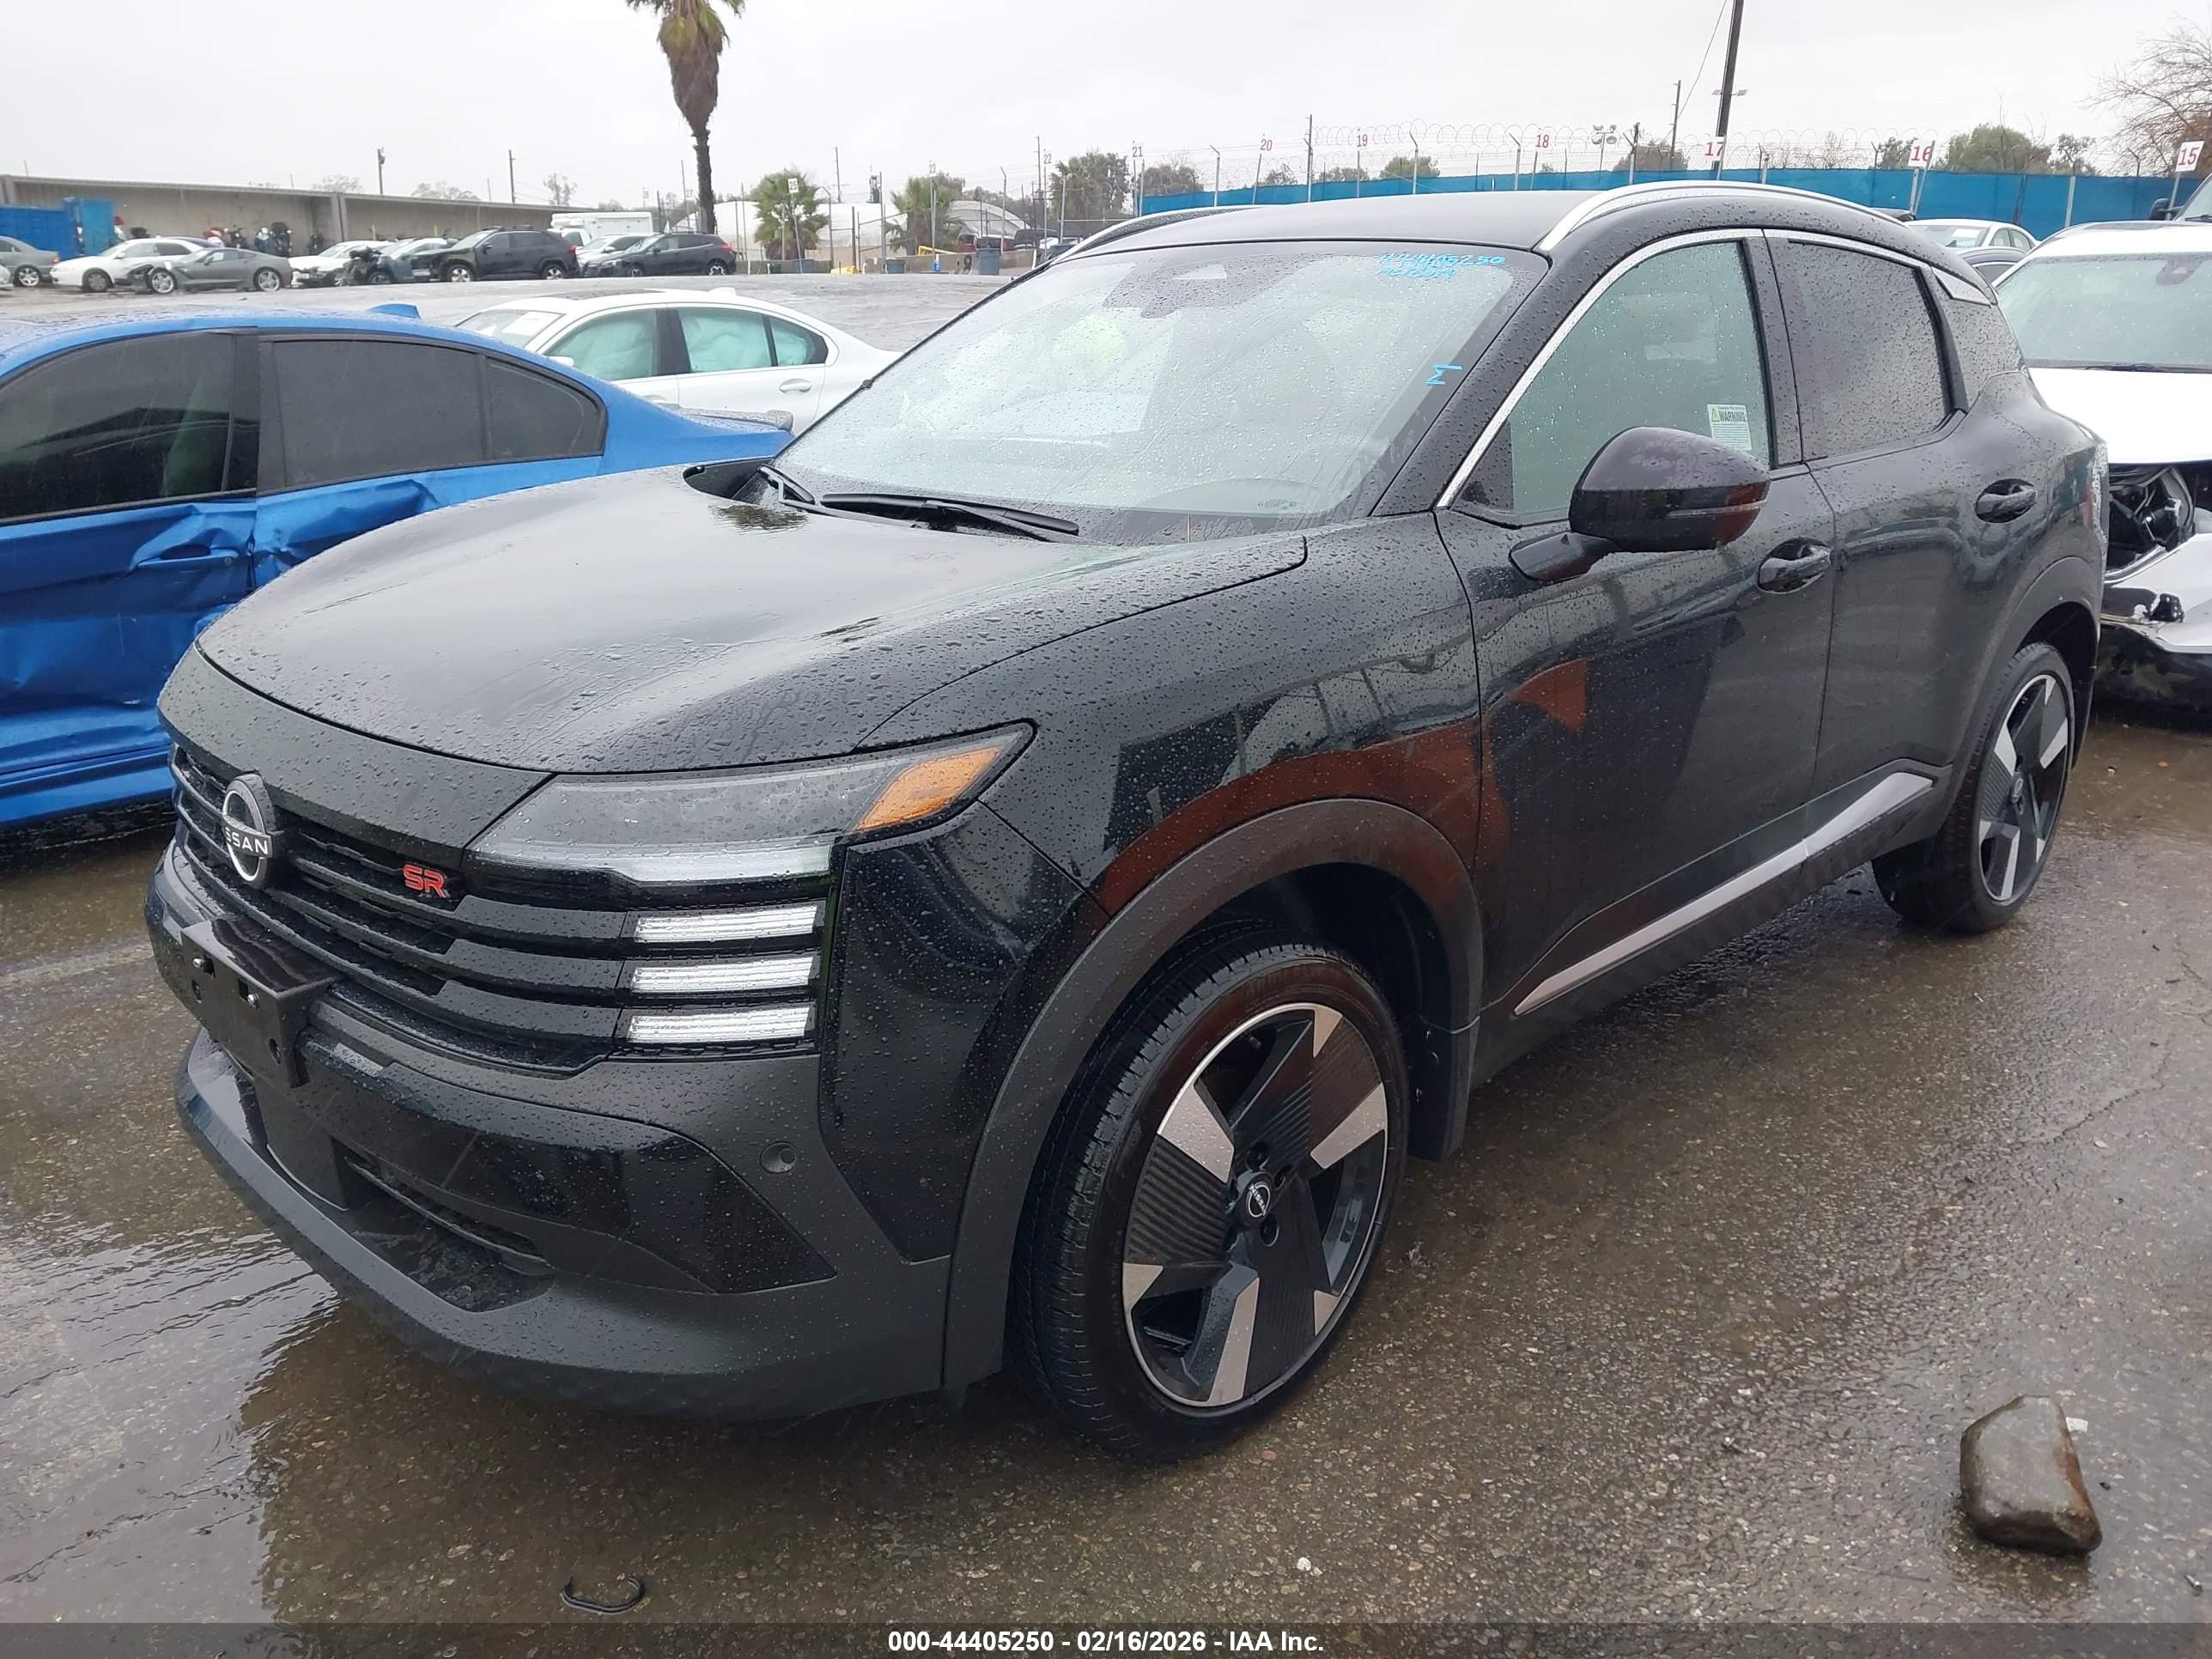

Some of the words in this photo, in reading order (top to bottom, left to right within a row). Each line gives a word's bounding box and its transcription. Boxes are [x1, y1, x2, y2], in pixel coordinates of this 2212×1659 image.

[1260, 138, 1273, 151] 20
[1357, 134, 1368, 147] 19
[1534, 133, 1550, 148] 18
[1132, 146, 1143, 157] 21
[1705, 141, 1726, 156] 17
[1911, 145, 1932, 161] 16
[2178, 147, 2200, 166] 15
[404, 864, 447, 899] SR
